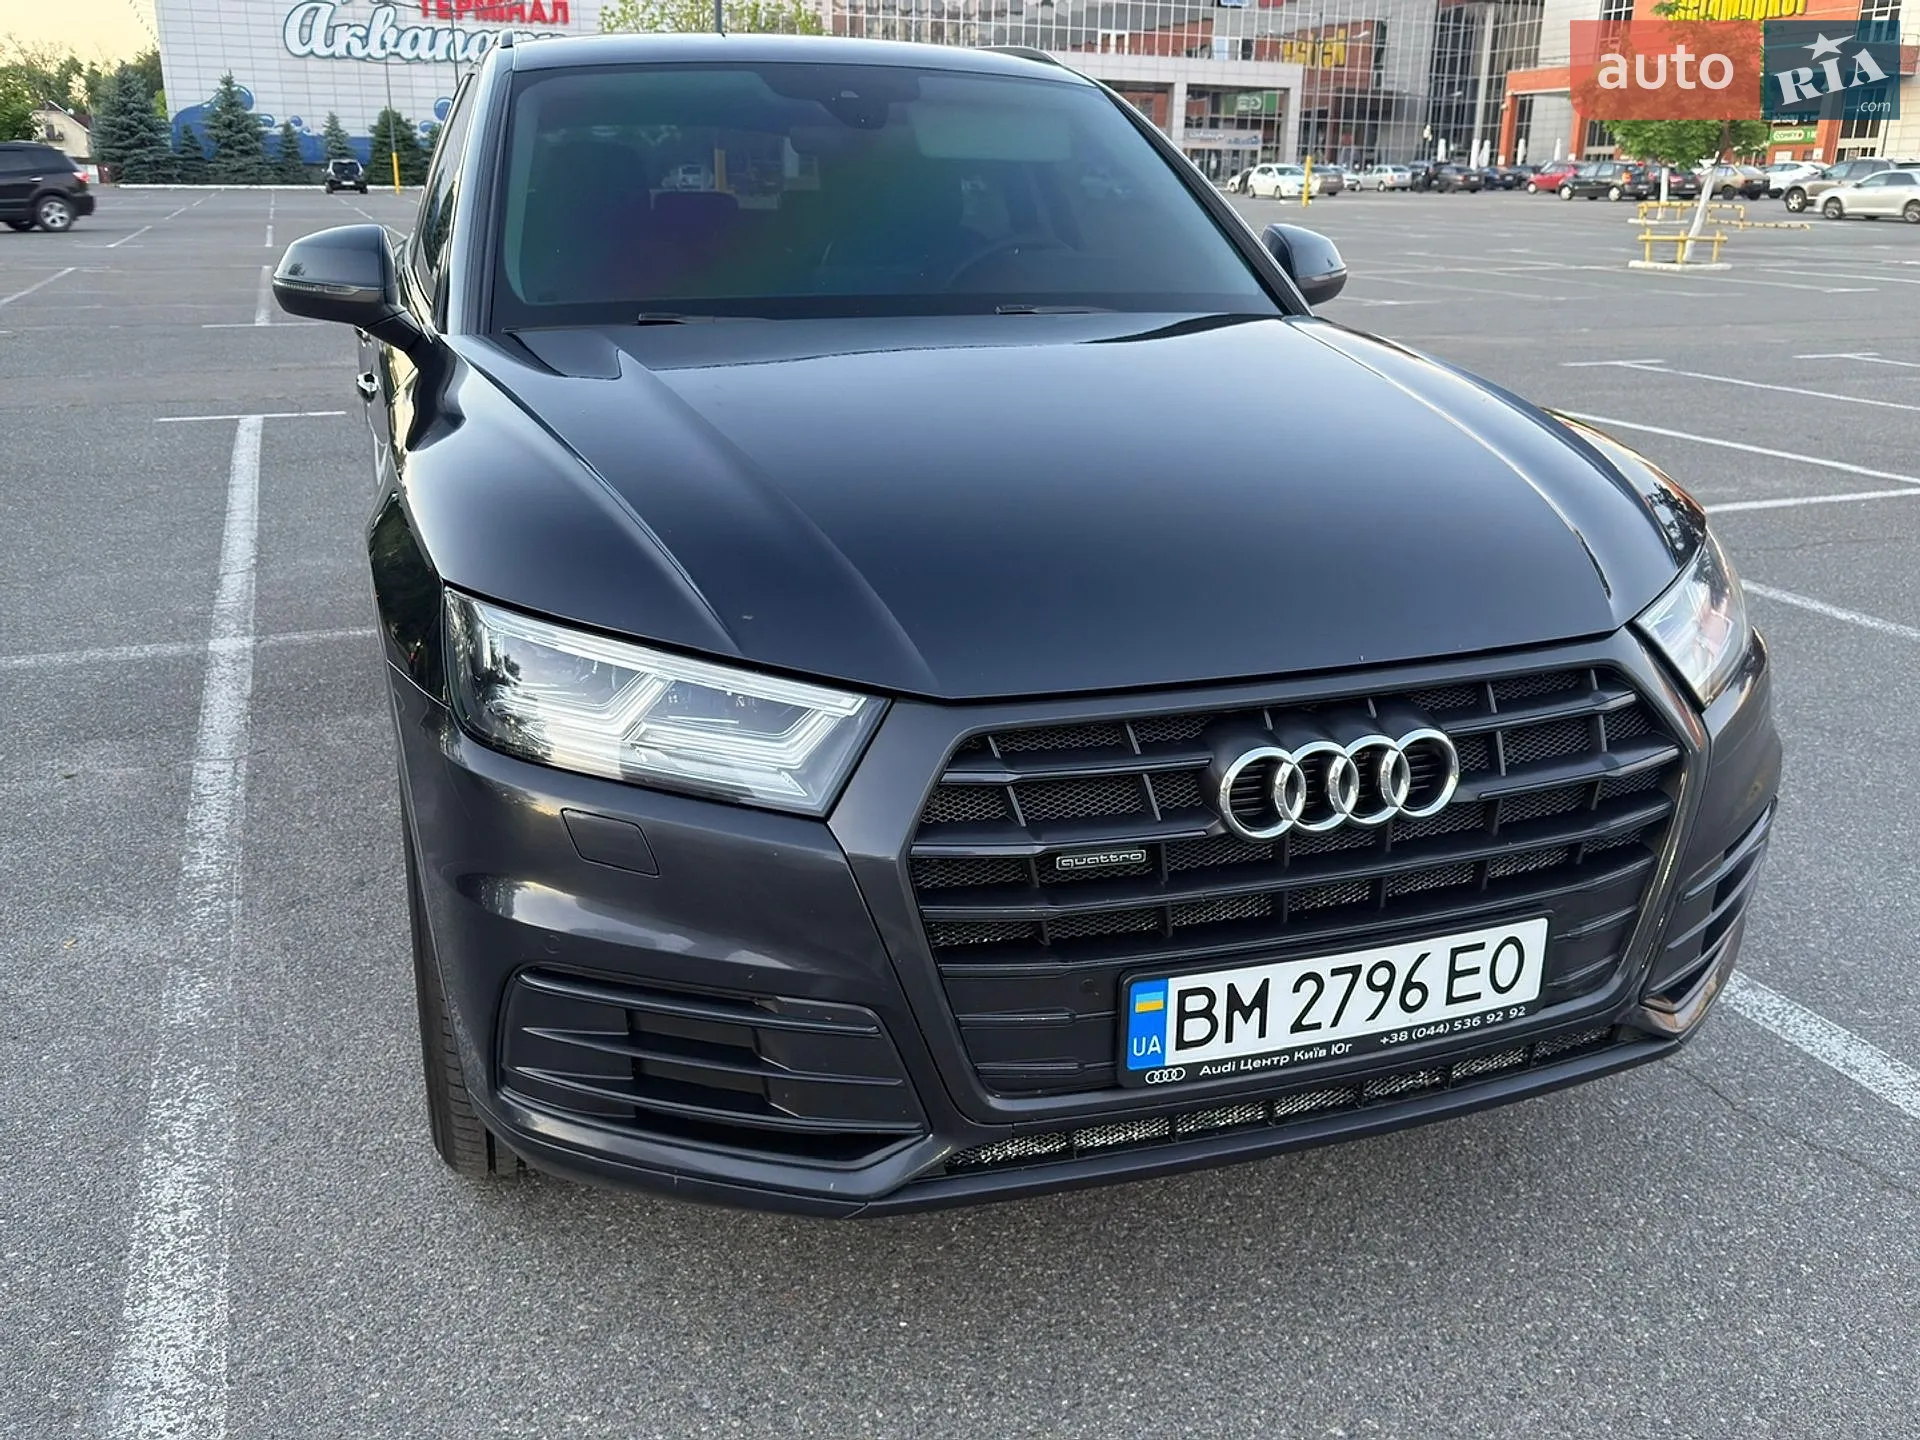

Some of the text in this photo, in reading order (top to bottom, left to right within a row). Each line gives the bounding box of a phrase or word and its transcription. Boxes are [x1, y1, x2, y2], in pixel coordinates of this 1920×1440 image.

[283, 2, 566, 62] Аквапа
[1060, 852, 1143, 869] quattro
[1174, 936, 1525, 1051] BM 2796 EO
[1132, 1036, 1162, 1058] UA
[1199, 1006, 1526, 1077] Audi Центр Київ Юг +38 (044) 536 92 92
